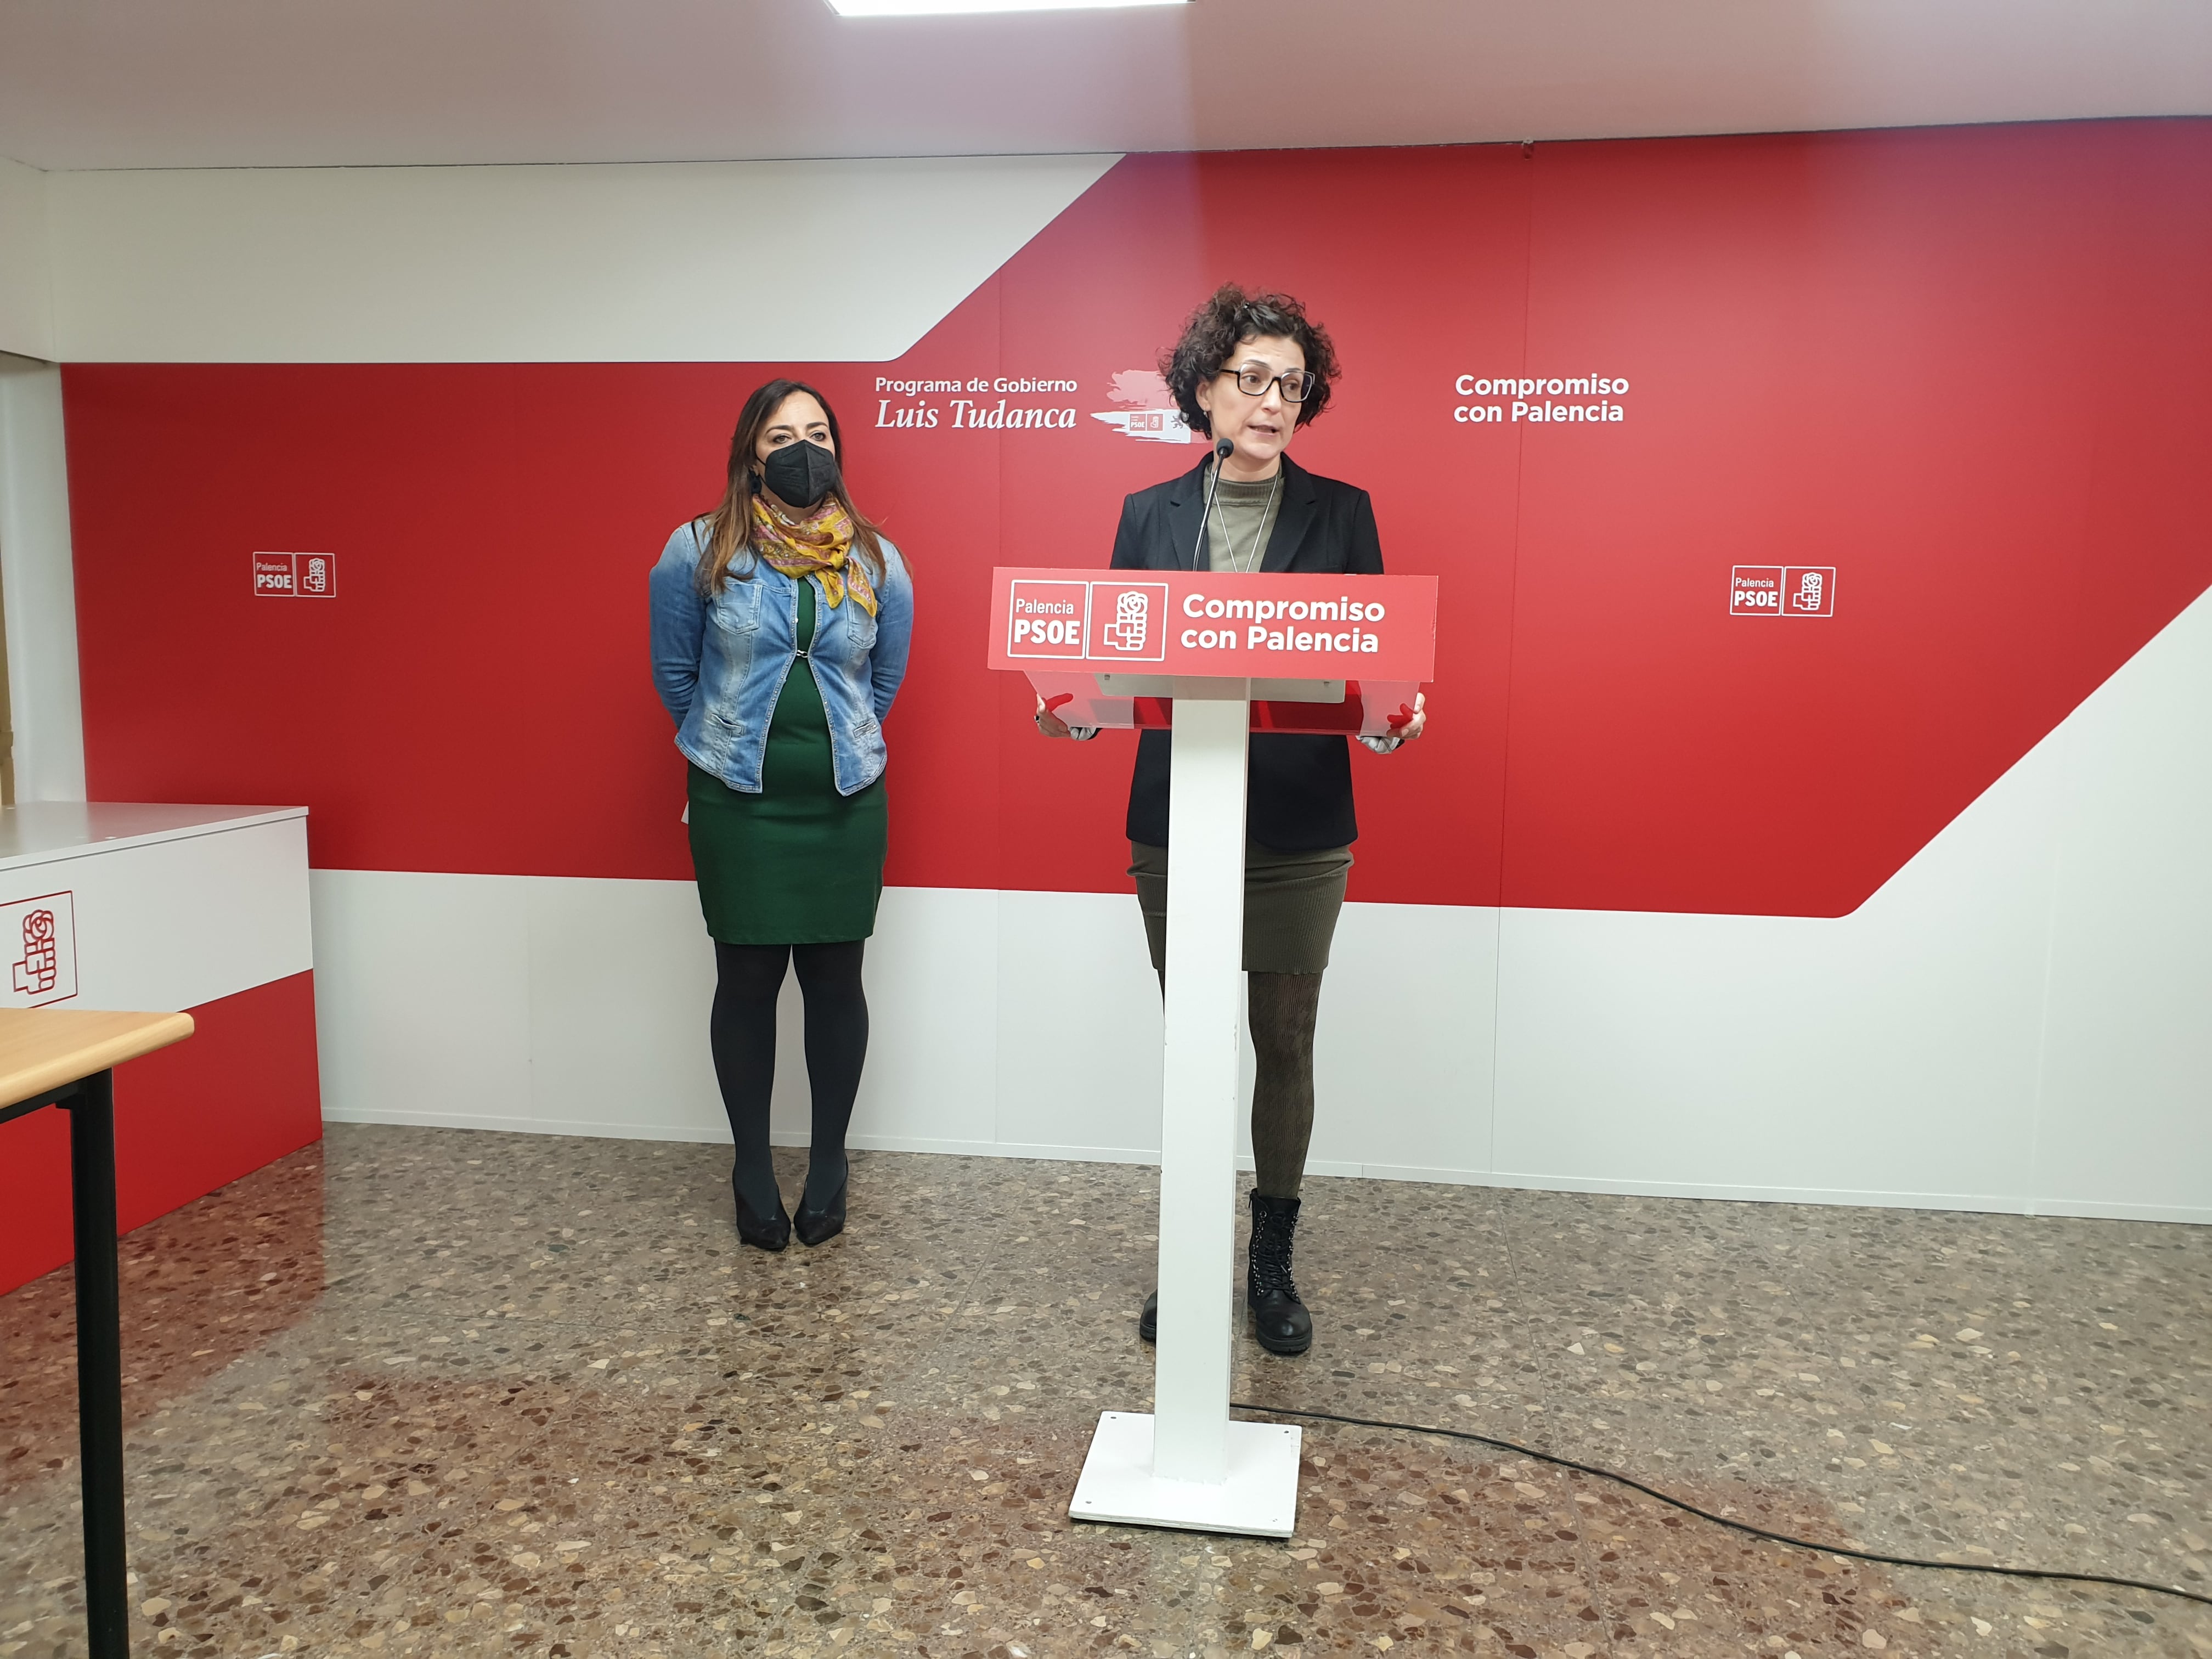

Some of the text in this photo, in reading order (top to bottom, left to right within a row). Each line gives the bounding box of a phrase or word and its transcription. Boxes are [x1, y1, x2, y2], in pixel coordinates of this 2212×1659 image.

[875, 377, 1077, 397] Programa de Gobierno
[1455, 373, 1629, 399] Compromiso
[874, 399, 1077, 429] Luis Tudanca
[1454, 400, 1624, 422] con Palencia
[256, 562, 287, 572] Palencia
[257, 574, 292, 589] PSOE
[1735, 577, 1774, 588] Palencia
[1015, 598, 1074, 615] Palencia
[1182, 594, 1385, 624] Compromiso
[1734, 590, 1779, 607] PSOE
[1013, 619, 1081, 645] PSOE
[1180, 626, 1379, 652] con Palencia
